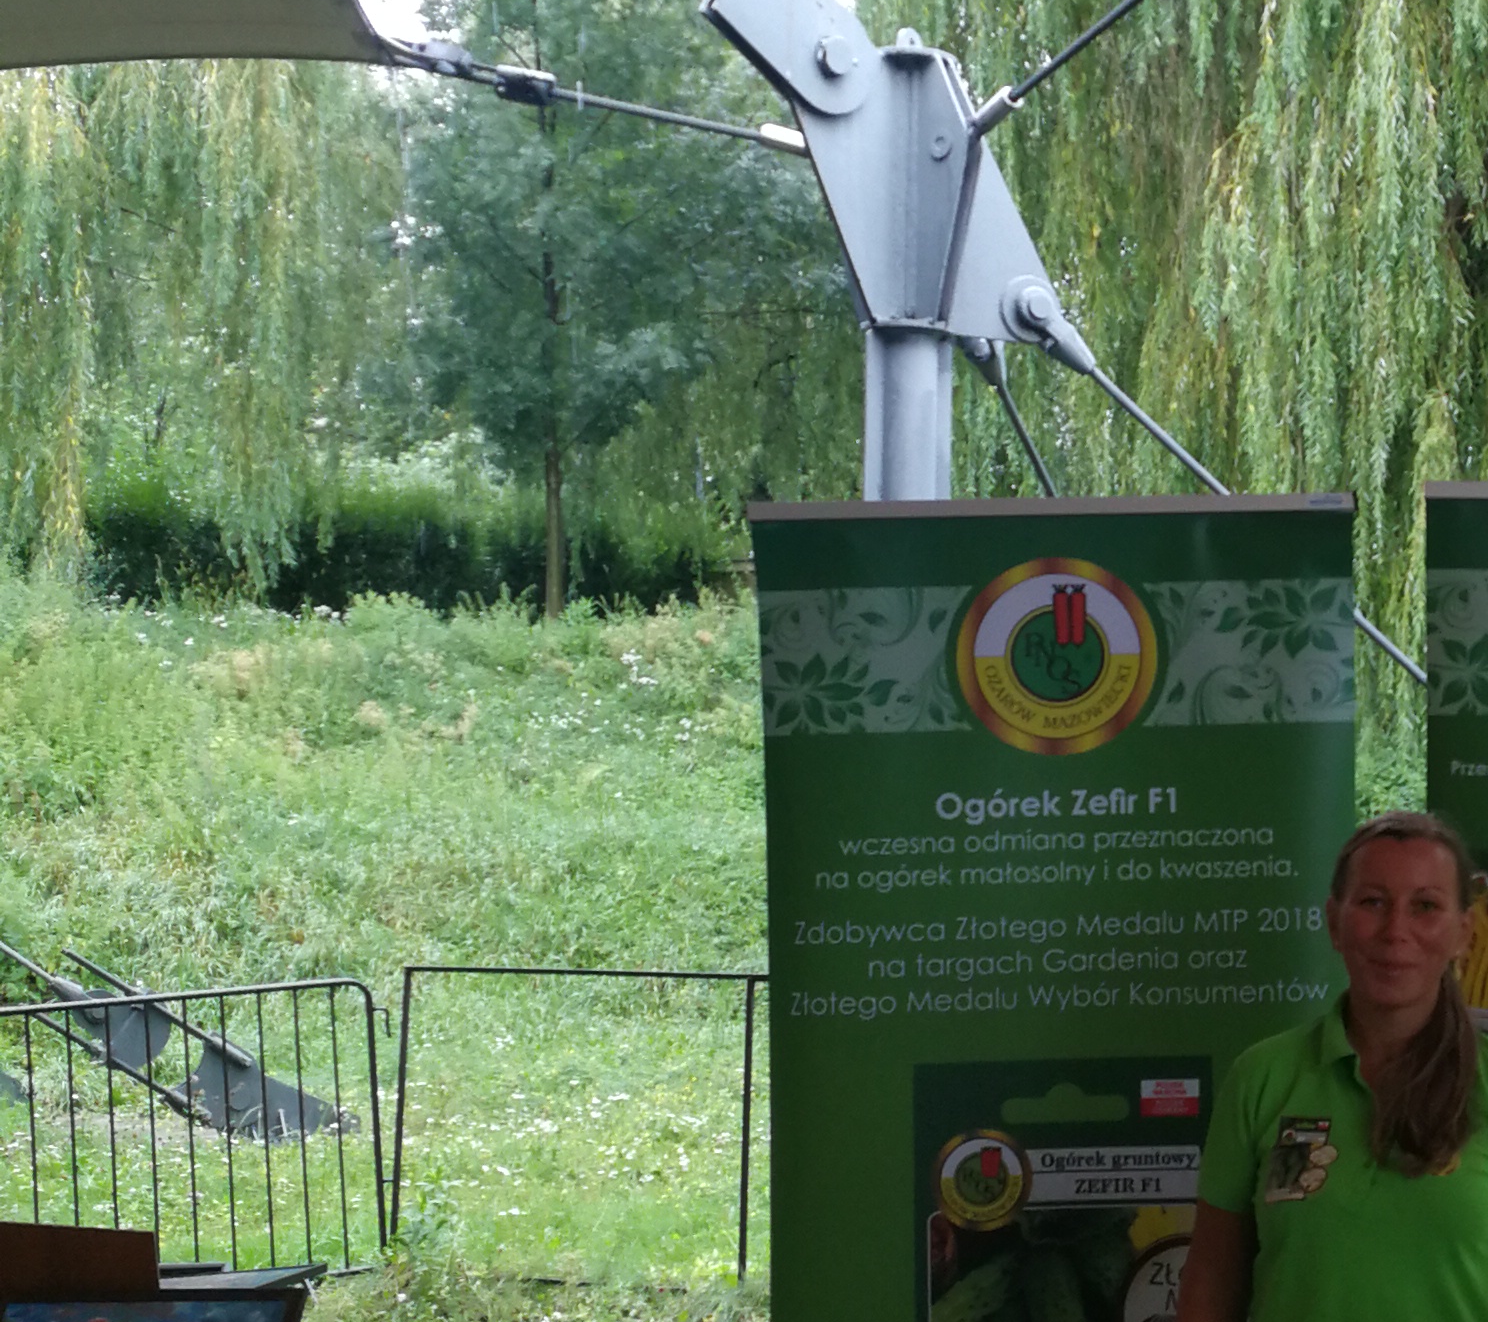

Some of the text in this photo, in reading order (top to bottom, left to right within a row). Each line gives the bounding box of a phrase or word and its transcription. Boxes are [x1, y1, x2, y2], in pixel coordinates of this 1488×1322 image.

[1024, 631, 1083, 695] PNOS
[935, 786, 1177, 826] Ogórek Zefir F1
[838, 827, 1275, 856] wczesna odmiana przeznaczona
[815, 854, 1299, 894] na ogórek małosolny i do kwaszenia.
[793, 906, 1323, 948] Zdobywca Złotego Medalu MTP 2018
[867, 947, 1248, 982] na targach Gardenia oraz
[790, 977, 1329, 1021] Złotego Medalu Wybór Konsumentów
[1040, 1150, 1198, 1172] Ogórek gruntowy
[1075, 1177, 1162, 1195] ZEFIR F1
[1149, 1262, 1181, 1287] ZŁ
